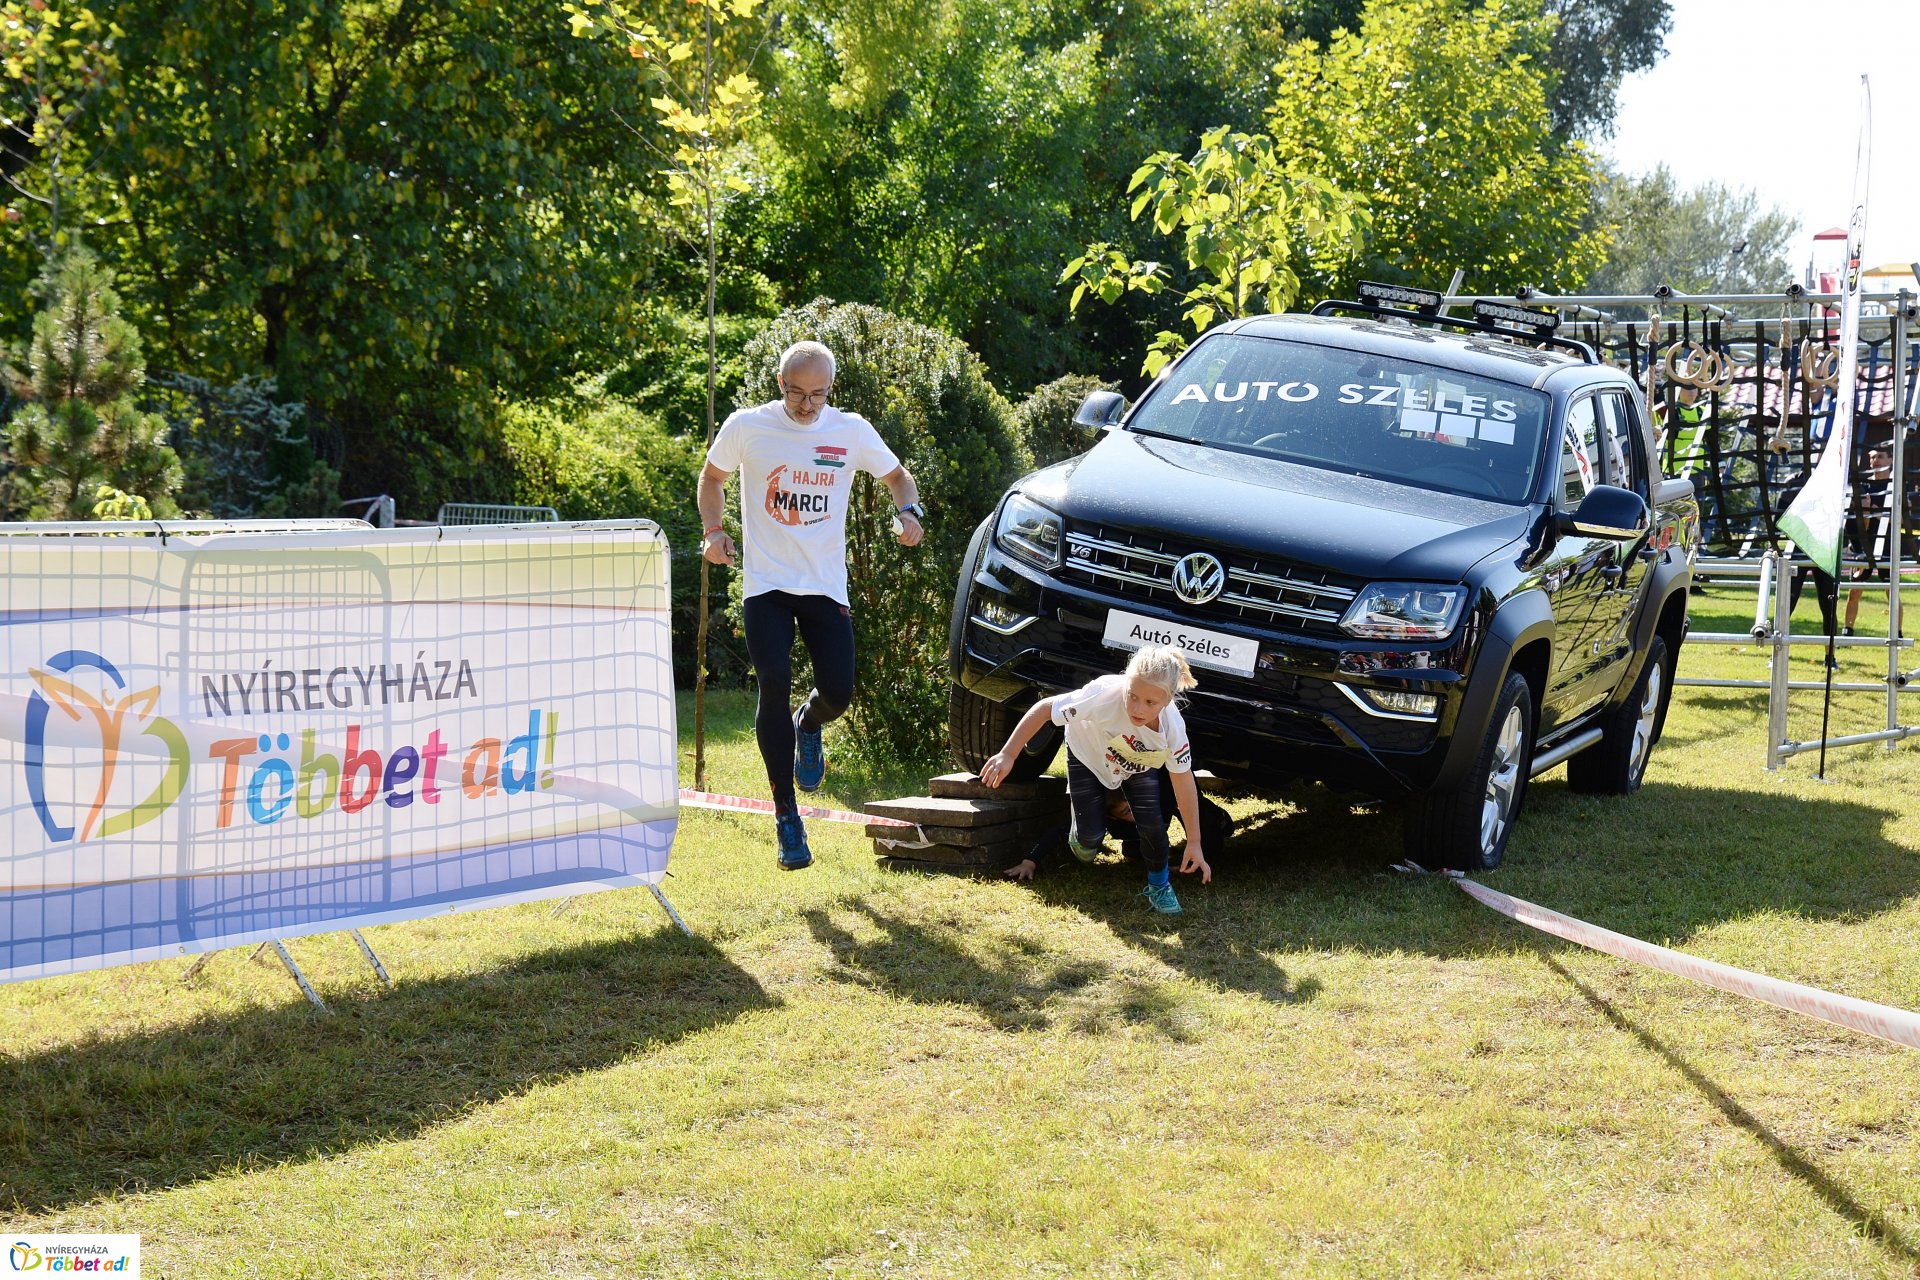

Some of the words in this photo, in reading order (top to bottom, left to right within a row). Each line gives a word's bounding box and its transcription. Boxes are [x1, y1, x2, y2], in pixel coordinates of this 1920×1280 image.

[792, 469, 836, 487] HAJRÁ
[773, 491, 829, 513] MARCI
[1070, 543, 1092, 559] V6
[1129, 624, 1172, 646] Autó
[1175, 634, 1231, 660] Széles
[201, 650, 478, 718] NYÍREGYHÁZA
[208, 723, 449, 829] Többet
[460, 708, 559, 800] ad!
